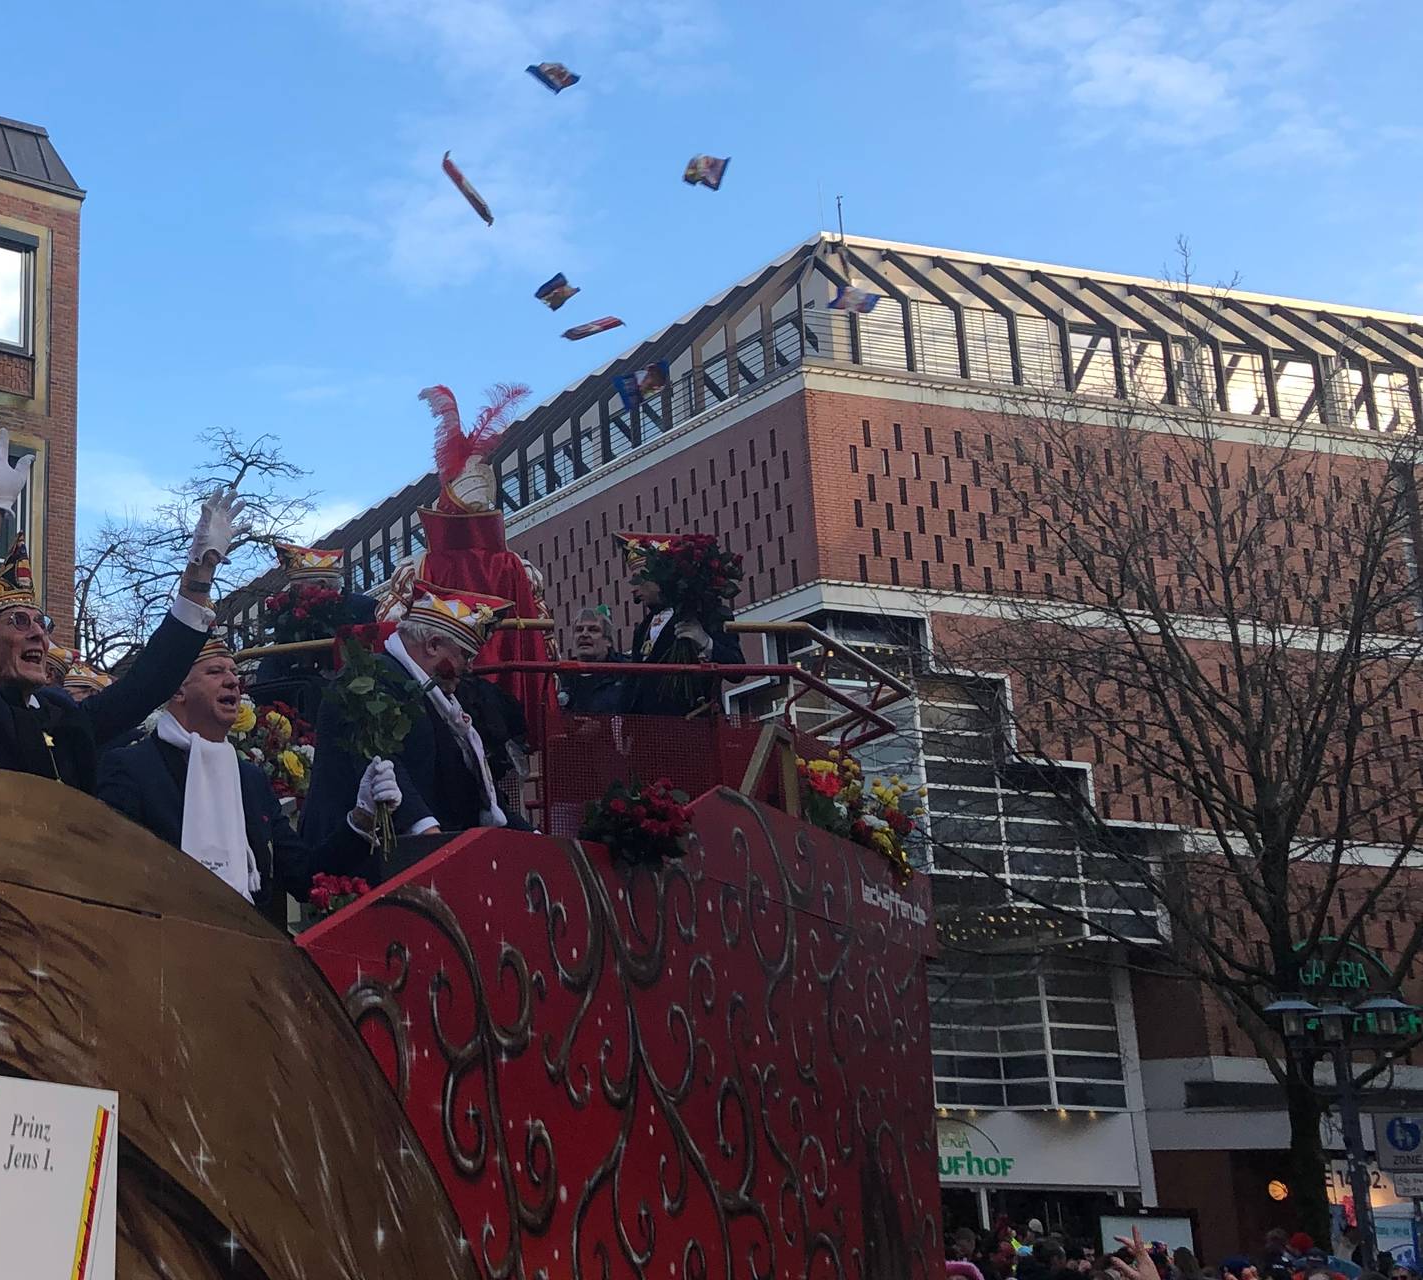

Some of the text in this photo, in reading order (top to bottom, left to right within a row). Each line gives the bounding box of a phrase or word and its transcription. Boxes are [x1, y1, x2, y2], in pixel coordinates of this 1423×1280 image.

[1299, 960, 1370, 988] GAERIA
[11, 1113, 51, 1142] Prinz
[3, 1144, 39, 1170] Jens
